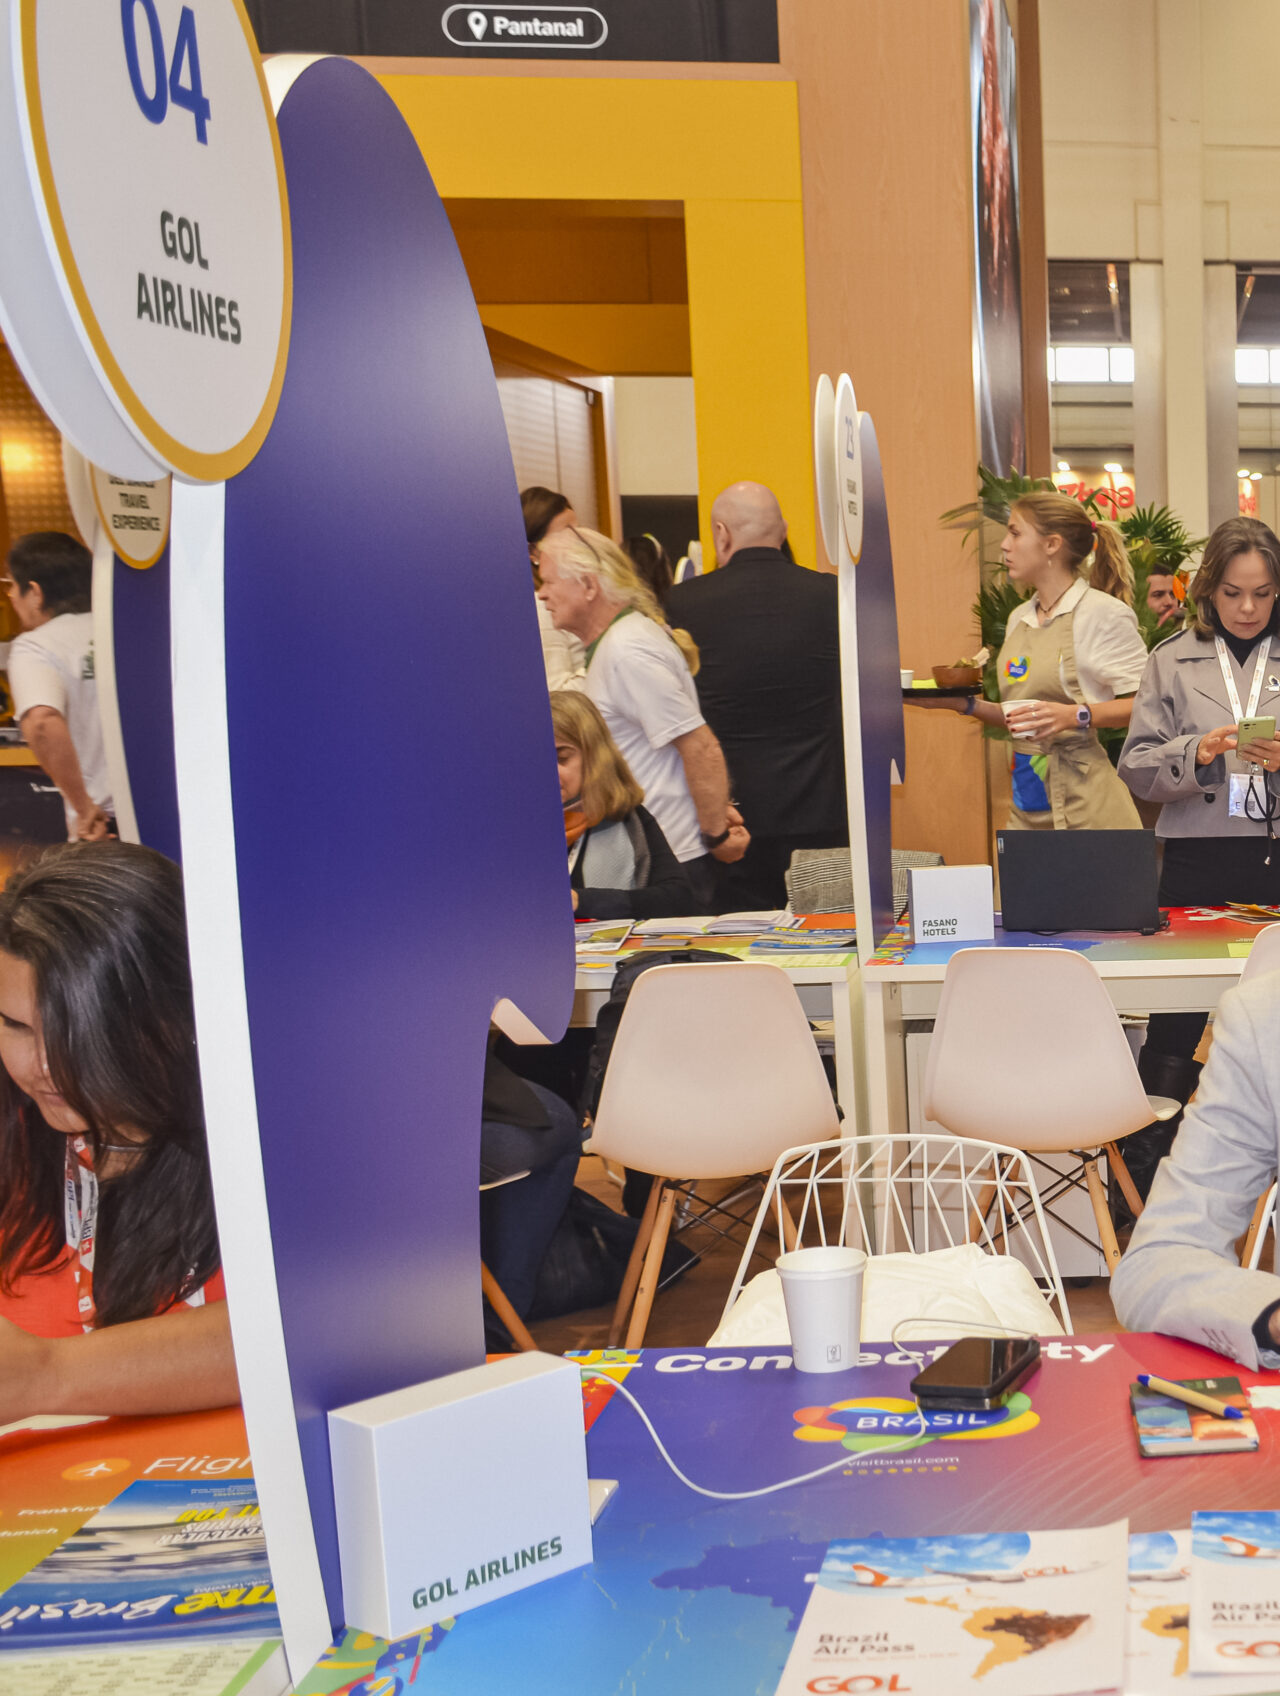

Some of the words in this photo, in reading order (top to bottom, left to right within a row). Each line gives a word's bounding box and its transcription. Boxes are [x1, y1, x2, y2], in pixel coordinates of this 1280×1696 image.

[492, 15, 585, 38] Pantanal
[118, 0, 211, 146] 04
[159, 210, 210, 271] GOL
[136, 271, 242, 345] AIRLINES
[922, 918, 958, 928] FASANO
[922, 927, 957, 937] HOTELS
[856, 1412, 988, 1429] BRASIL
[0, 1527, 58, 1537] unich
[412, 1577, 459, 1610] GOL
[464, 1535, 563, 1591] AIRLINES
[1212, 1601, 1280, 1611] Brazil
[1212, 1612, 1245, 1622] Air
[818, 1632, 890, 1644] Brazil
[813, 1645, 852, 1655] Air
[859, 1643, 916, 1655] Pass
[806, 1673, 913, 1695] GOL
